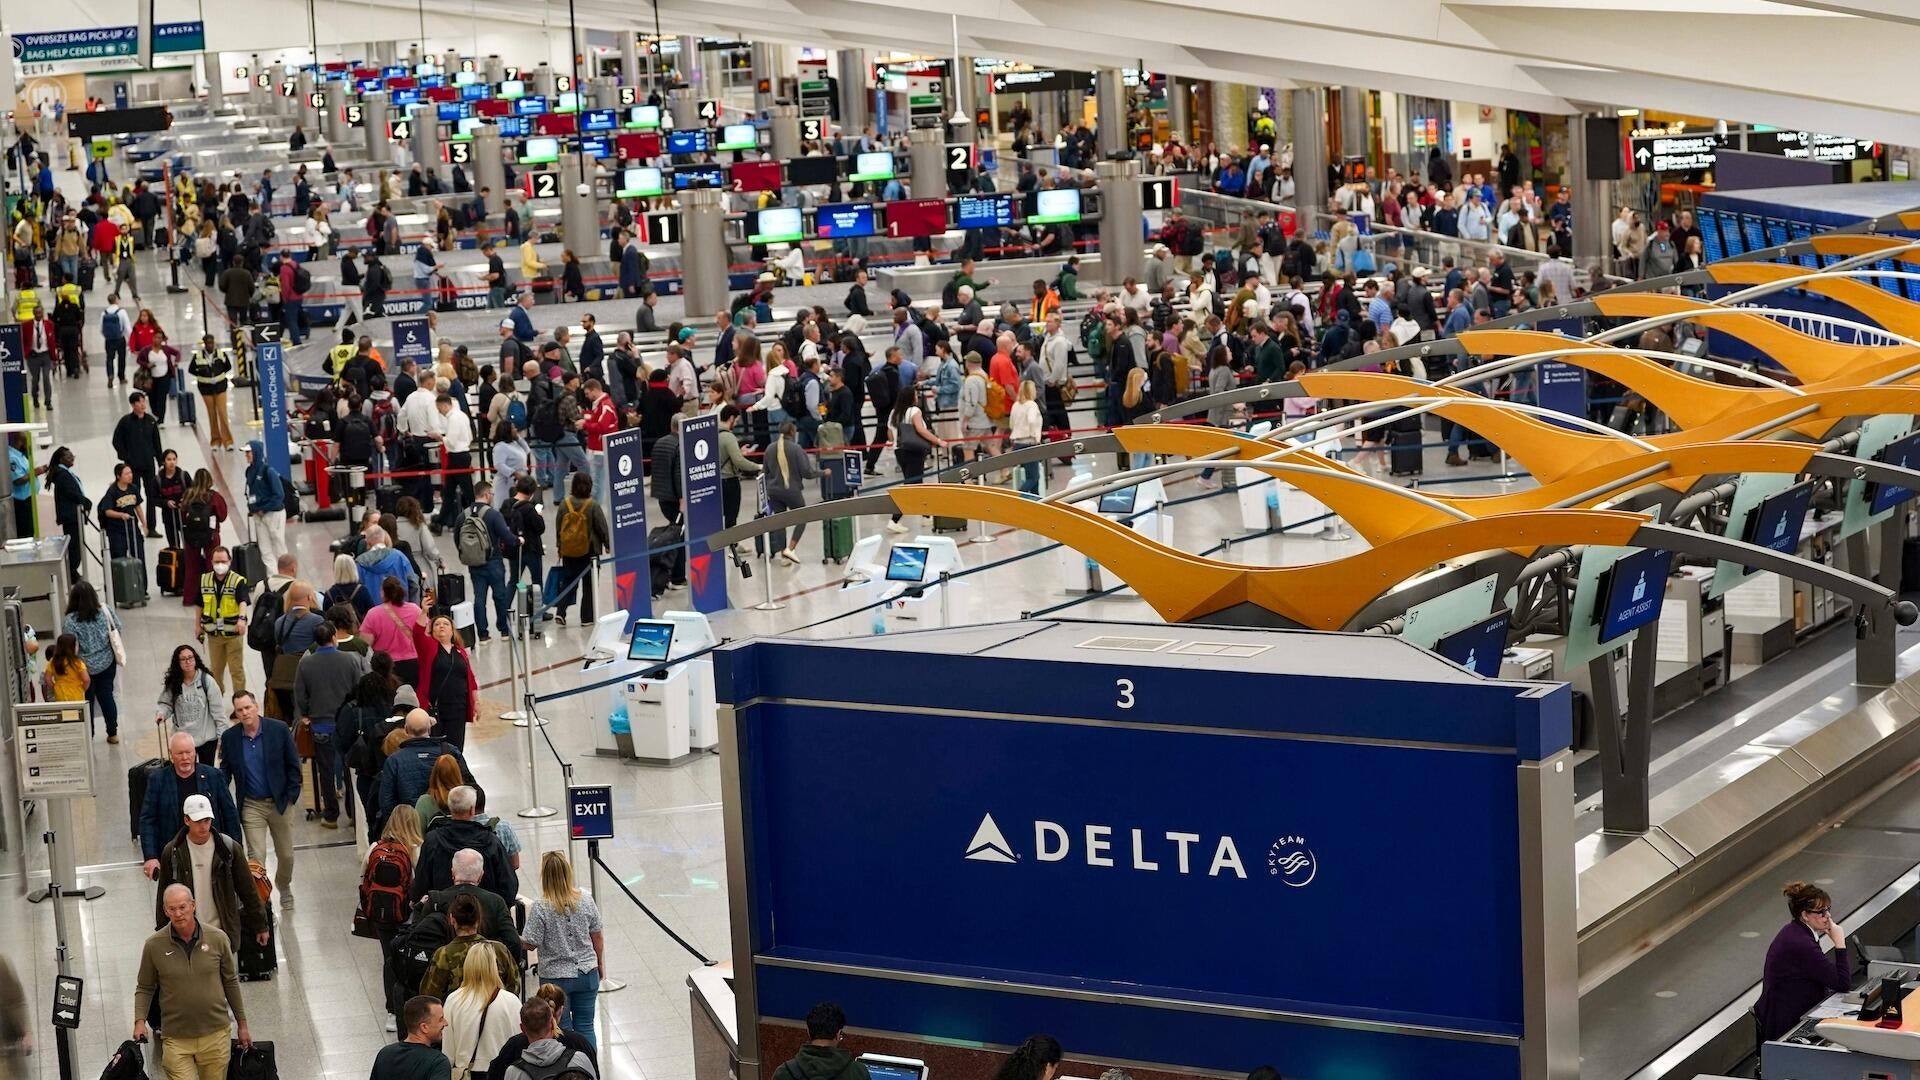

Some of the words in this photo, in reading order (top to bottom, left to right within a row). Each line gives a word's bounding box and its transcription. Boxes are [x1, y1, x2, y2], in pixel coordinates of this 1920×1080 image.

[25, 31, 67, 46] OVERSIZE
[68, 30, 88, 43] BAG
[88, 28, 124, 42] PICK-UP
[166, 26, 194, 35] DELTA
[26, 48, 46, 60] BAG
[46, 47, 69, 58] HELP
[69, 45, 104, 57] CENTER
[236, 67, 247, 79] 9
[258, 74, 269, 87] 8
[507, 68, 518, 81] 7
[283, 83, 294, 96] 7
[557, 77, 569, 91] 6
[311, 93, 324, 108] 6
[622, 88, 634, 105] 5
[349, 106, 361, 122] 5
[701, 102, 715, 118] 4
[393, 122, 408, 139] 4
[805, 121, 818, 140] 3
[453, 144, 469, 163] 3
[951, 147, 968, 170] 2
[538, 174, 555, 197] 2
[733, 179, 743, 192] 2
[1153, 182, 1163, 208] 1
[658, 216, 670, 243] 1
[890, 221, 899, 236] 1
[267, 363, 278, 409] PreCheck
[271, 410, 280, 430] TSA
[691, 421, 710, 431] DELTA
[615, 436, 633, 446] DELTA
[689, 466, 701, 474] SCAN
[706, 462, 716, 470] TAG
[689, 471, 703, 482] YOUR
[703, 470, 716, 478] BAGS
[613, 481, 627, 491] DROP
[626, 478, 639, 486] BAGS
[617, 488, 630, 497] WITH
[1409, 610, 1419, 625] 57
[1617, 606, 1636, 623] AGENT
[1635, 599, 1653, 615] ASSIST
[1116, 678, 1136, 709] 3
[574, 802, 607, 816] EXIT
[1034, 820, 1248, 879] DELTA
[1268, 835, 1305, 875] SKYTEAM
[60, 994, 77, 1007] Enter
